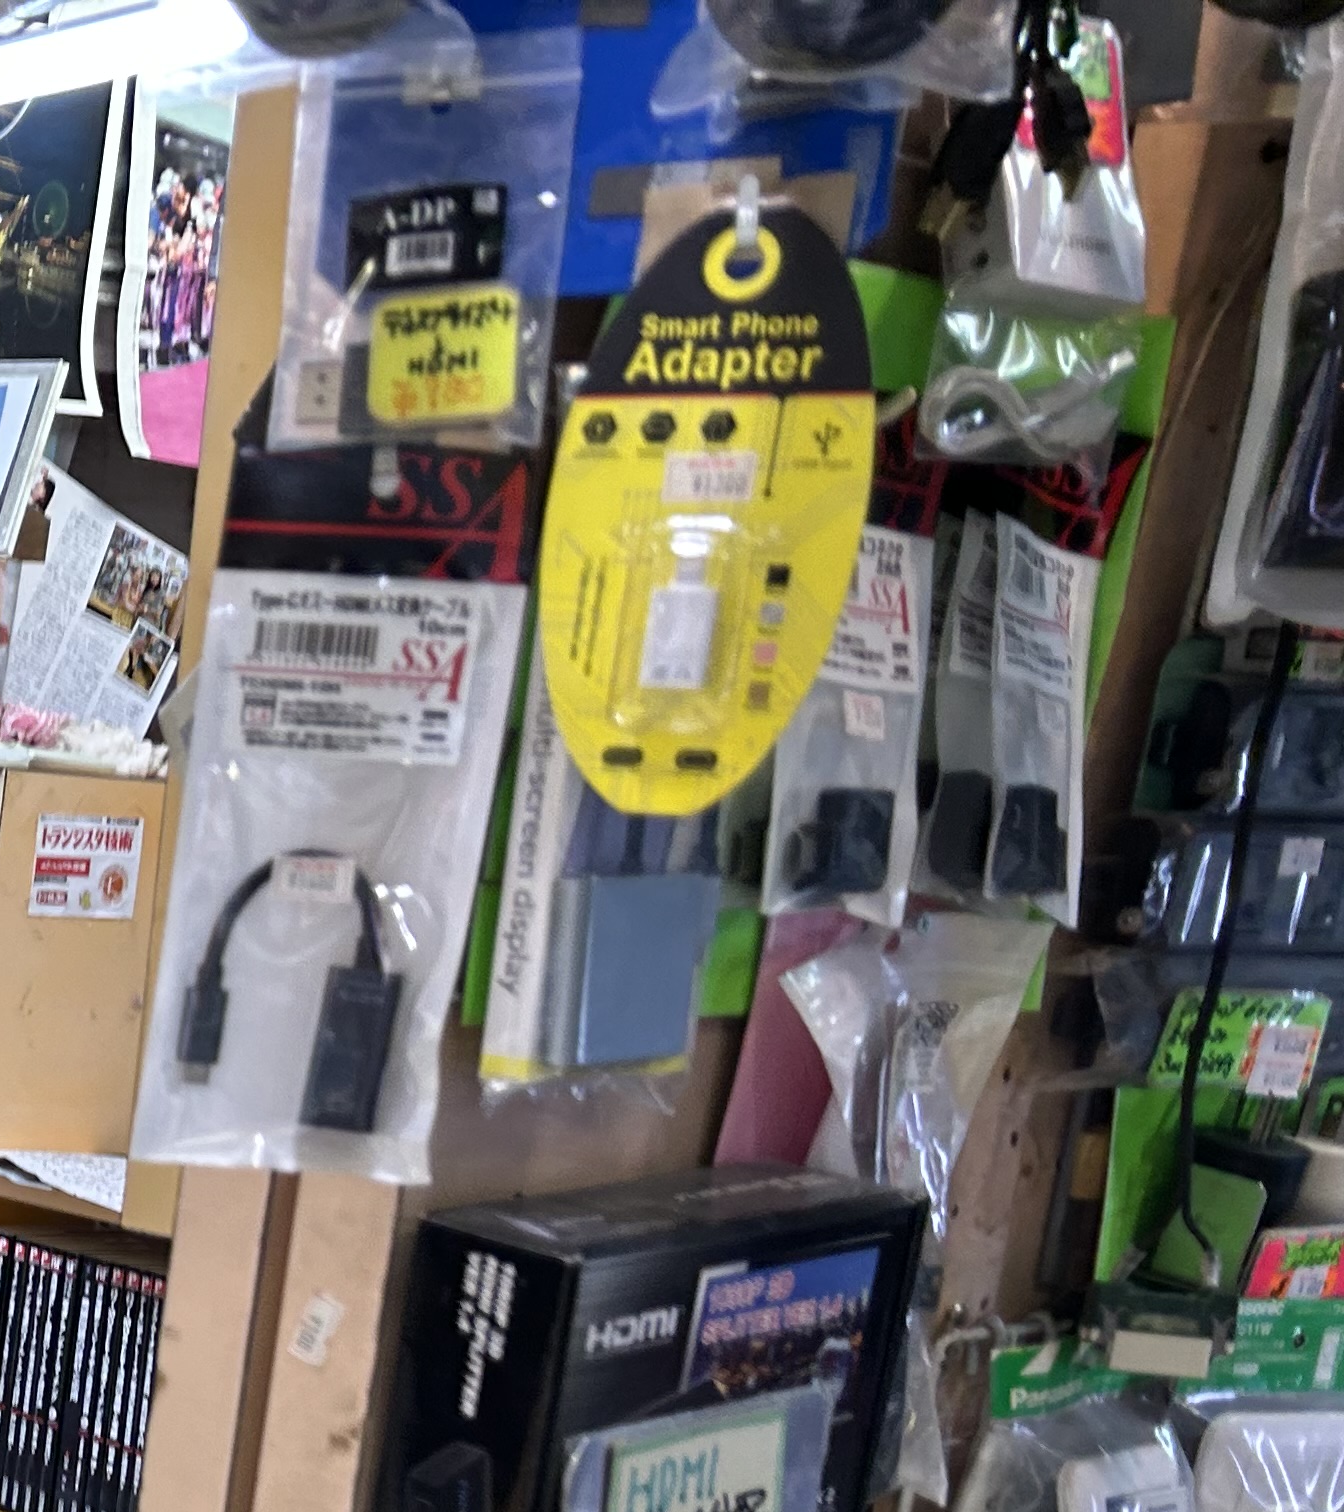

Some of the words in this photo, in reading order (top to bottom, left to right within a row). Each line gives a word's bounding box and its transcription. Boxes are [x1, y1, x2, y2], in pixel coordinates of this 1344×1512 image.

[640, 312, 721, 341] Smart
[730, 310, 820, 340] Phone
[624, 339, 824, 392] Adapter
[498, 877, 537, 997] display
[584, 1304, 679, 1355] HDMI
